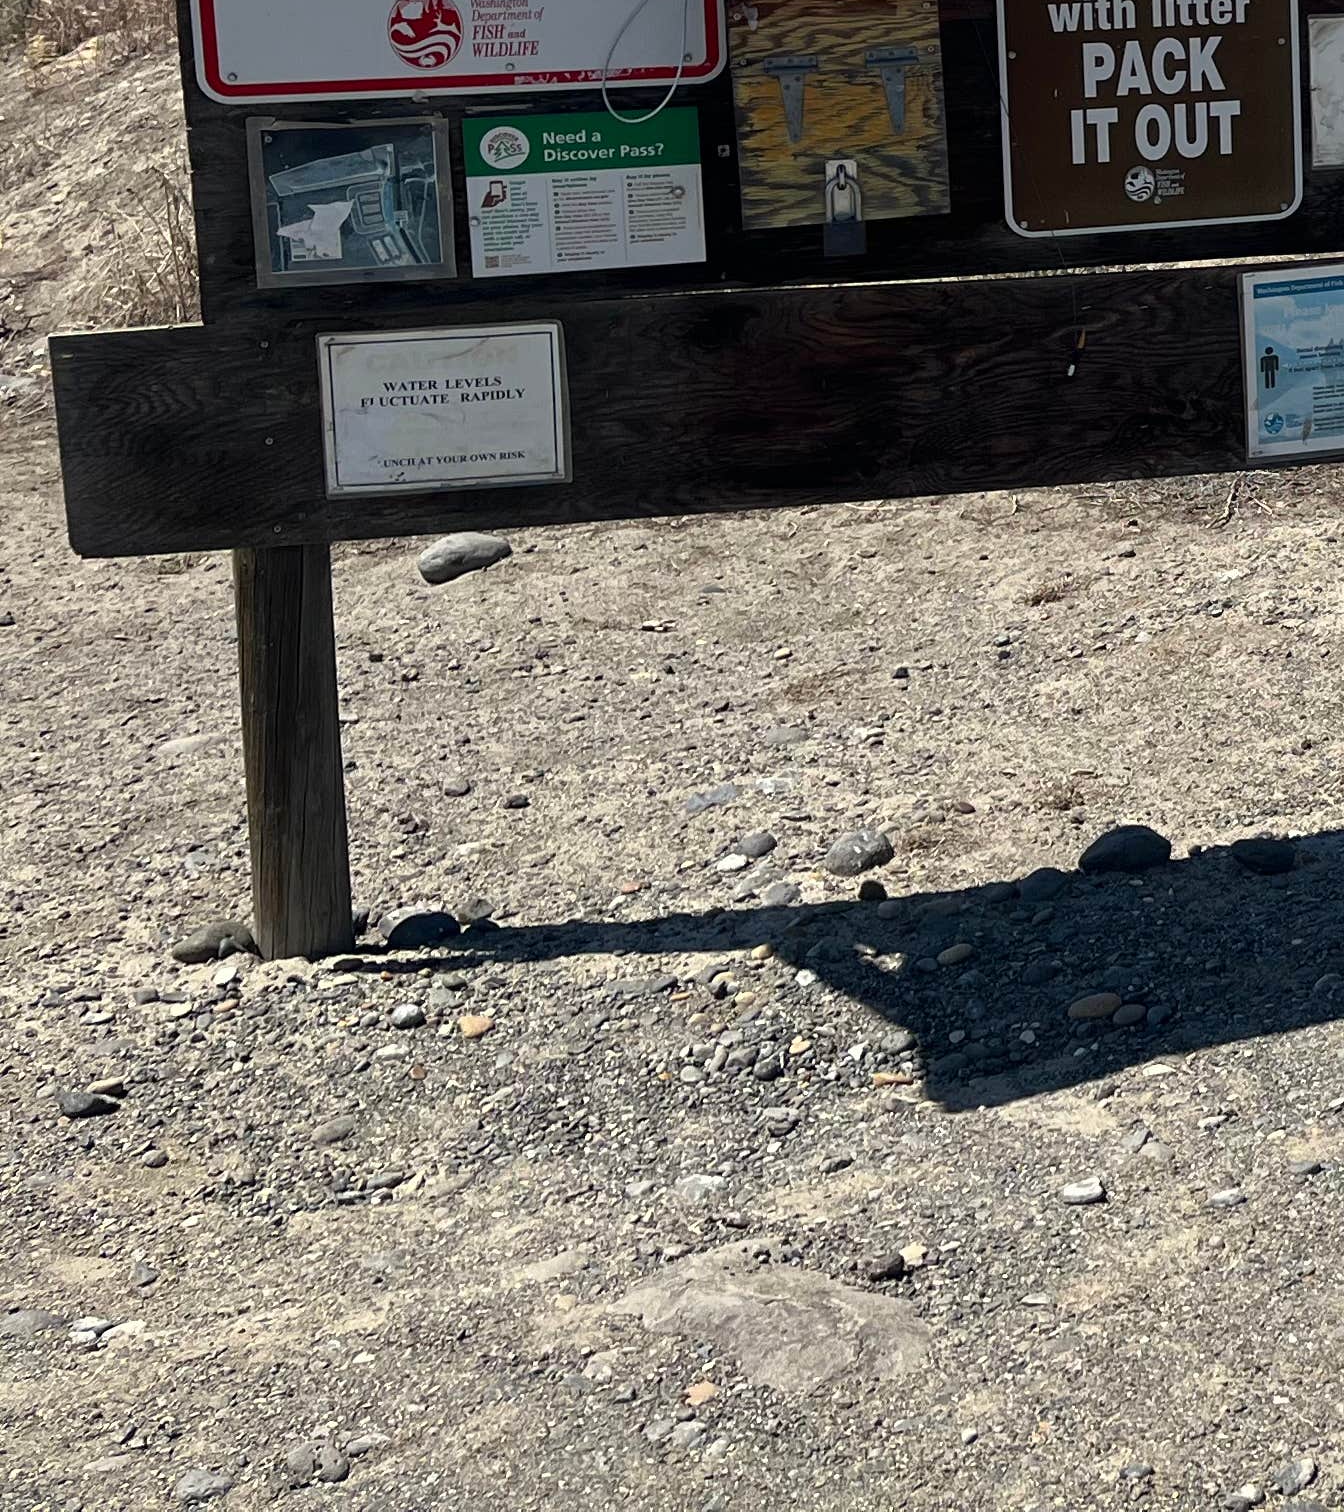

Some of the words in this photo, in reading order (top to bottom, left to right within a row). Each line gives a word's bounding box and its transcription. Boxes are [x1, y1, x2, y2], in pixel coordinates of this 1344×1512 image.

[471, 9, 532, 24] Department
[533, 6, 545, 22] of
[472, 23, 505, 41] FISH
[507, 28, 527, 39] and
[472, 40, 540, 58] WILDLIFE
[1081, 35, 1226, 99] PACK
[543, 129, 587, 145] Need
[591, 131, 601, 143] a
[1070, 106, 1119, 165] IT
[1134, 100, 1241, 162] OUT
[544, 144, 615, 162] Discover
[620, 142, 665, 158] Pass?
[383, 379, 439, 393] WATER
[445, 375, 502, 390] LEVELS
[460, 388, 526, 404] RAPIDLY
[418, 456, 434, 466] AT
[436, 454, 467, 465] YOUR
[470, 452, 496, 463] OWN
[499, 450, 526, 461] RISK
